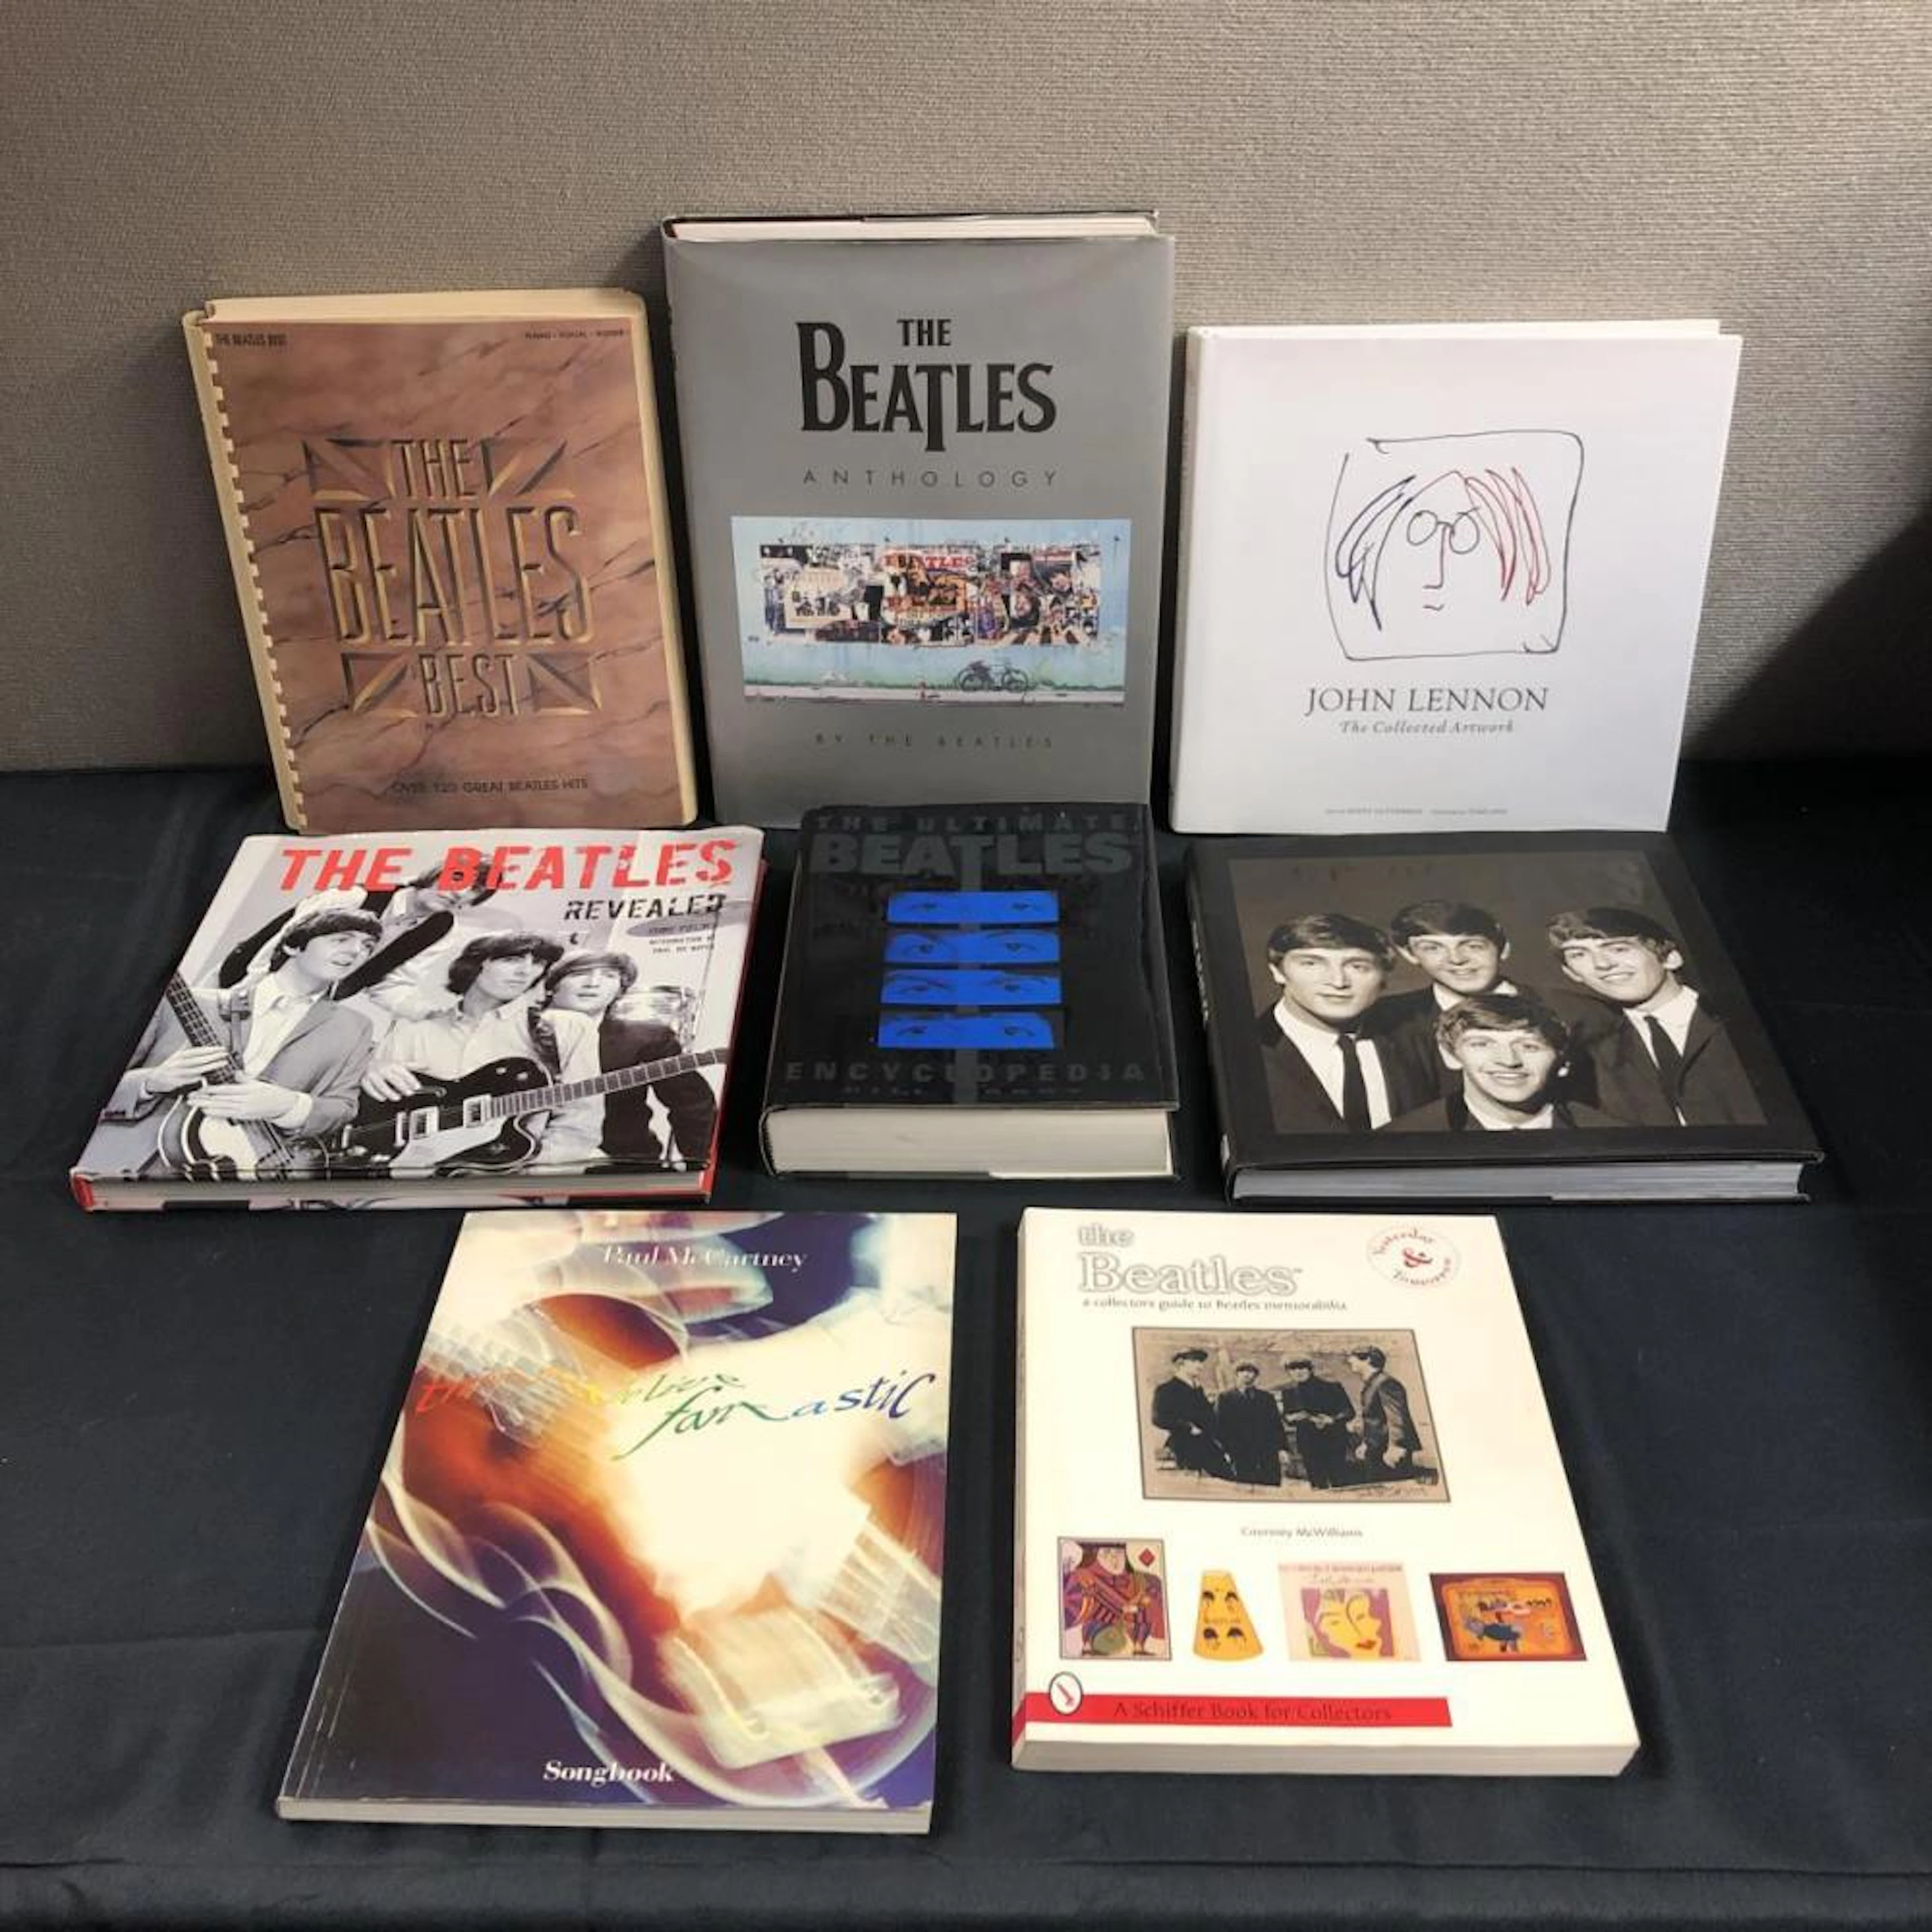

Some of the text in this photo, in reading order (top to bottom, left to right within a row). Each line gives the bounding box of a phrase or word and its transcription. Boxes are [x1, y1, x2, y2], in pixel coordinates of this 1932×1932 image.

[897, 319, 951, 347] THE
[795, 321, 1057, 452] BEATLES
[393, 439, 476, 499] THE
[803, 470, 1058, 487] ANTHOLOGY
[314, 505, 596, 646] BEATLES
[418, 654, 521, 717] BEST
[1304, 687, 1550, 717] JOHN LENNON
[1340, 719, 1514, 734] The Collected Artwork
[816, 815, 1130, 832] THE ULTIMATE
[278, 840, 742, 893] THE BEATLES
[810, 833, 1133, 883] BEATLES
[564, 893, 728, 921] REVEALED
[786, 1062, 1146, 1083] ENCYCLOPEDIA
[1078, 1223, 1135, 1247] the
[604, 1245, 660, 1264] Paul
[1158, 1299, 1194, 1311] guide
[1198, 1300, 1212, 1309] to
[1216, 1298, 1261, 1310] Beatles
[610, 1370, 937, 1460] fanastic
[1113, 1701, 1393, 1721] A Schiffer Book for Collectors
[543, 1759, 674, 1788] Songbook
